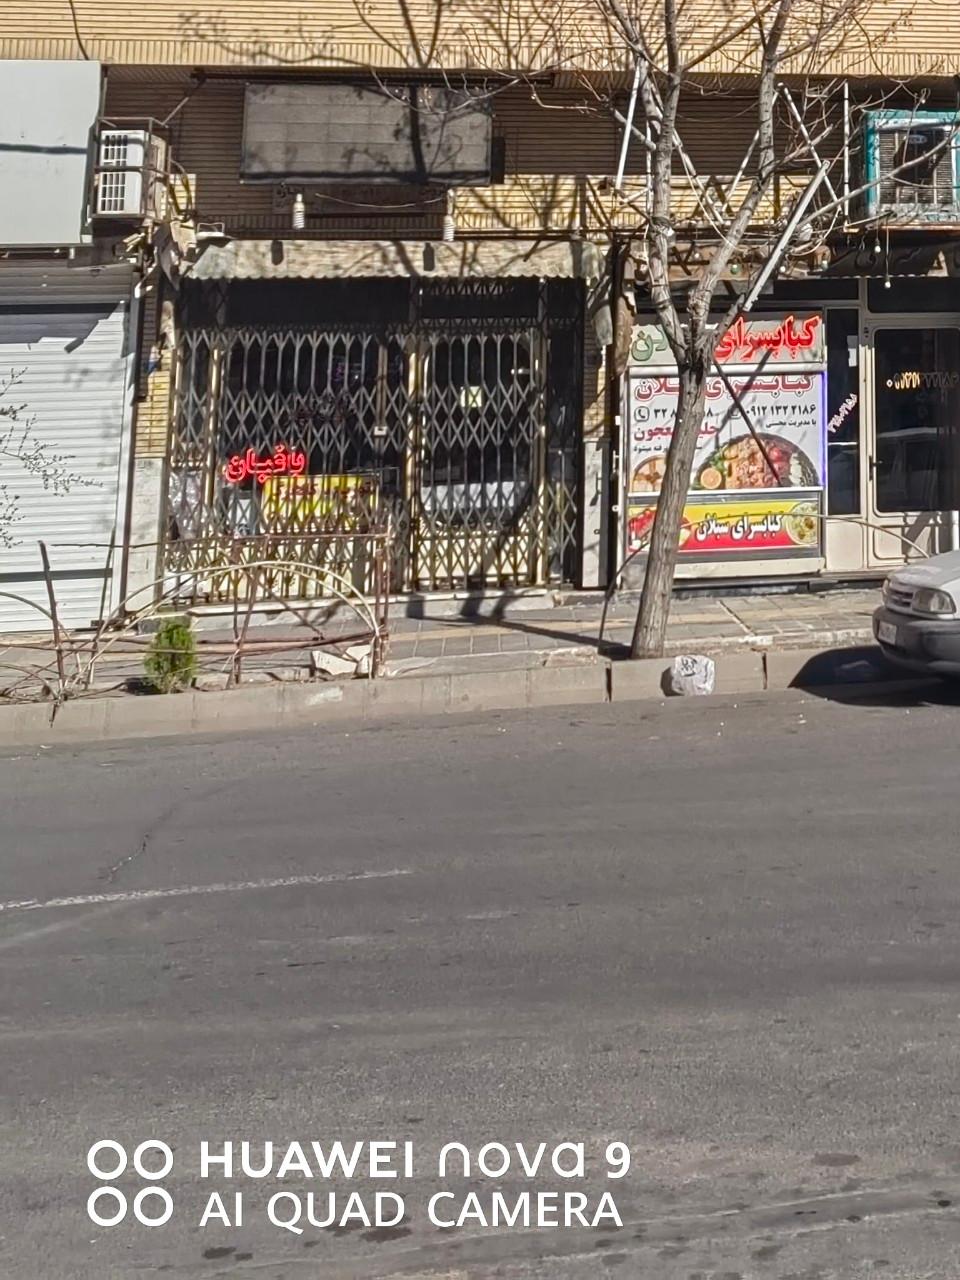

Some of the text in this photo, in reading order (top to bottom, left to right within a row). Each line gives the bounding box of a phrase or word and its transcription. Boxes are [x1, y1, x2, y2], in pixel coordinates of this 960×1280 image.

[791, 403, 816, 416] ۲۱۸۶
[634, 424, 674, 441] عجون
[732, 512, 786, 540] کبابسرای
